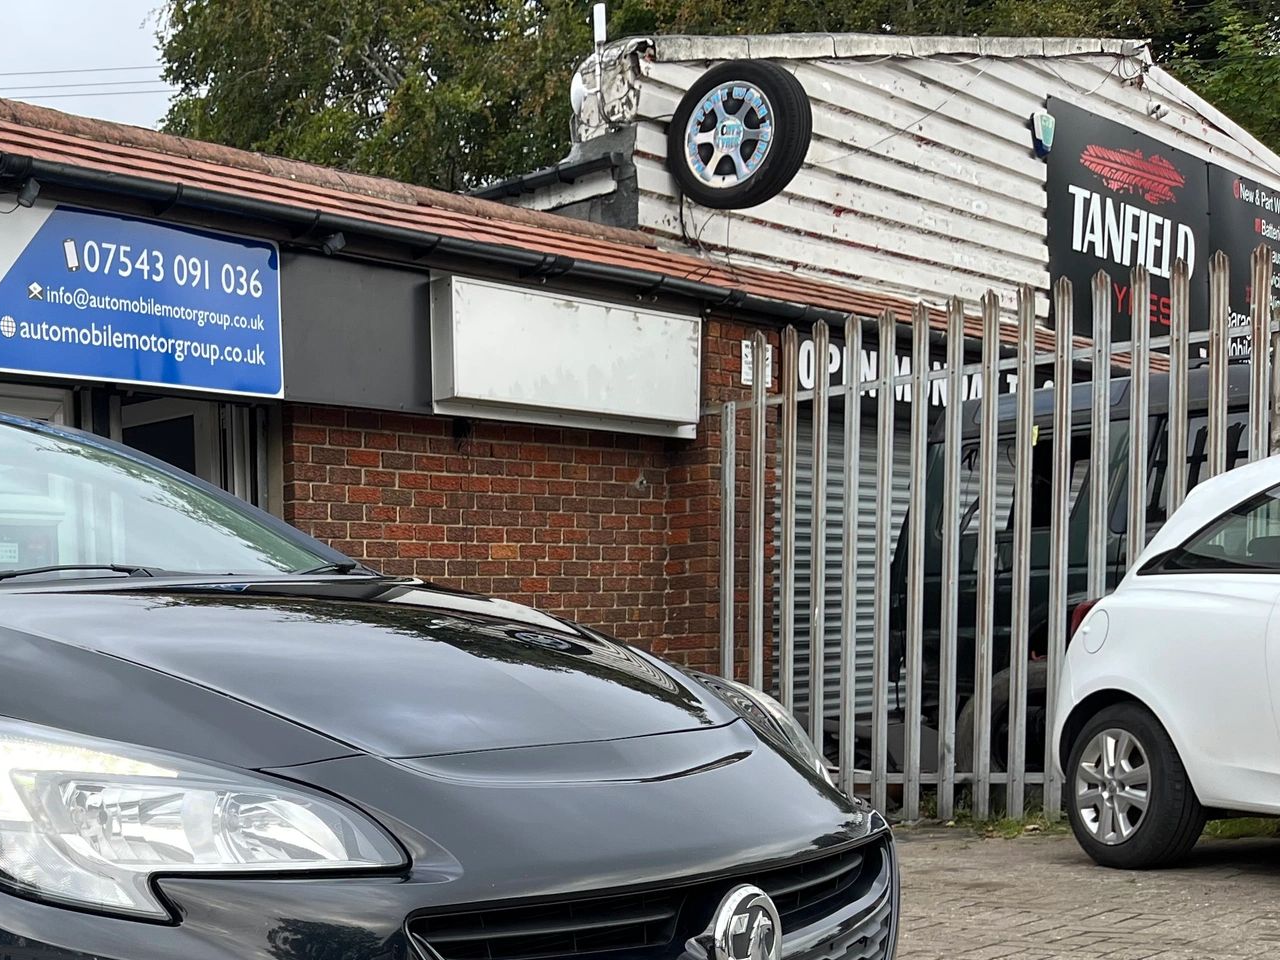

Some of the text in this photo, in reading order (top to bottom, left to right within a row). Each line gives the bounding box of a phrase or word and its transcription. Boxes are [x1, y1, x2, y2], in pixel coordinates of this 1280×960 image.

[1240, 183, 1255, 203] New
[1068, 184, 1196, 281] TANFIELD
[83, 240, 263, 298] 07543 091 036
[46, 286, 265, 331] info@automobilemotorgroup.co.uk
[1113, 283, 1172, 326] YES
[20, 320, 266, 366] automobilemotorgroup.co.uk
